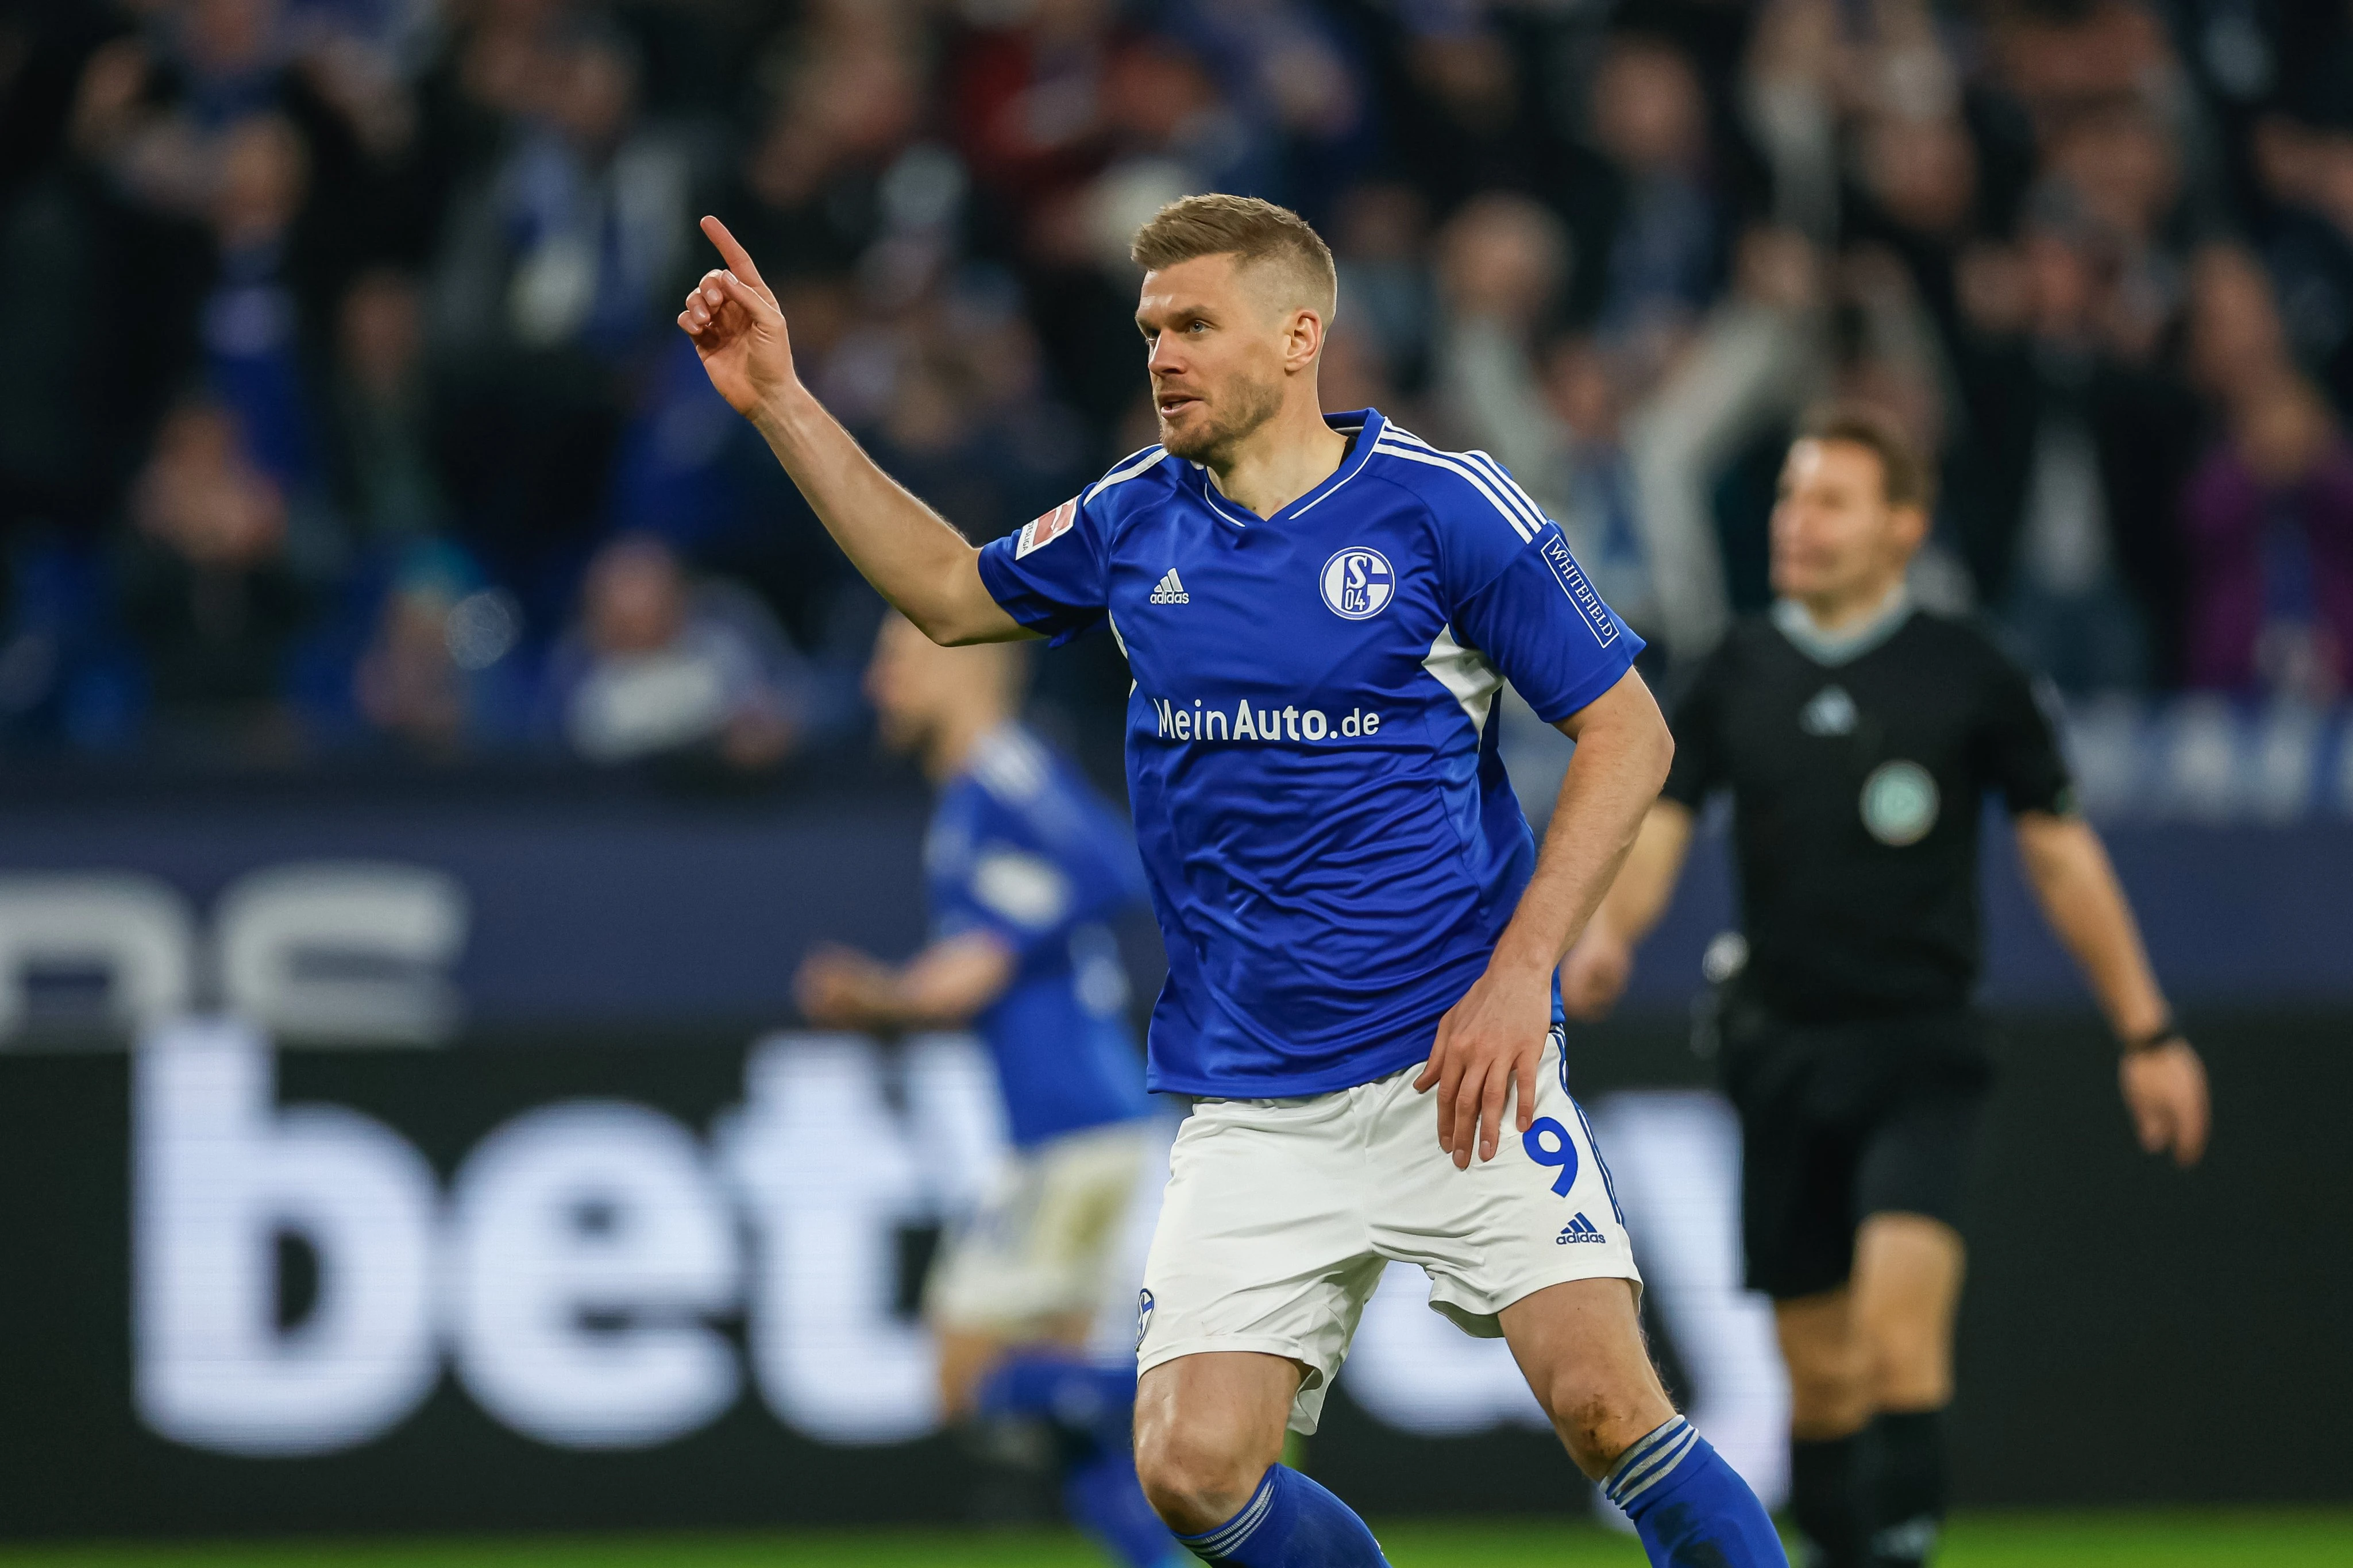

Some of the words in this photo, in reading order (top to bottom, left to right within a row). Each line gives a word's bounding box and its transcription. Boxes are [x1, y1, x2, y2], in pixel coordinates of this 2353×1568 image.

[1150, 591, 1189, 604] adidas
[1549, 543, 1613, 636] WHITEFIELD
[1154, 698, 1379, 741] MeinAuto.de
[1522, 1117, 1578, 1198] 9
[1556, 1232, 1606, 1245] adidas
